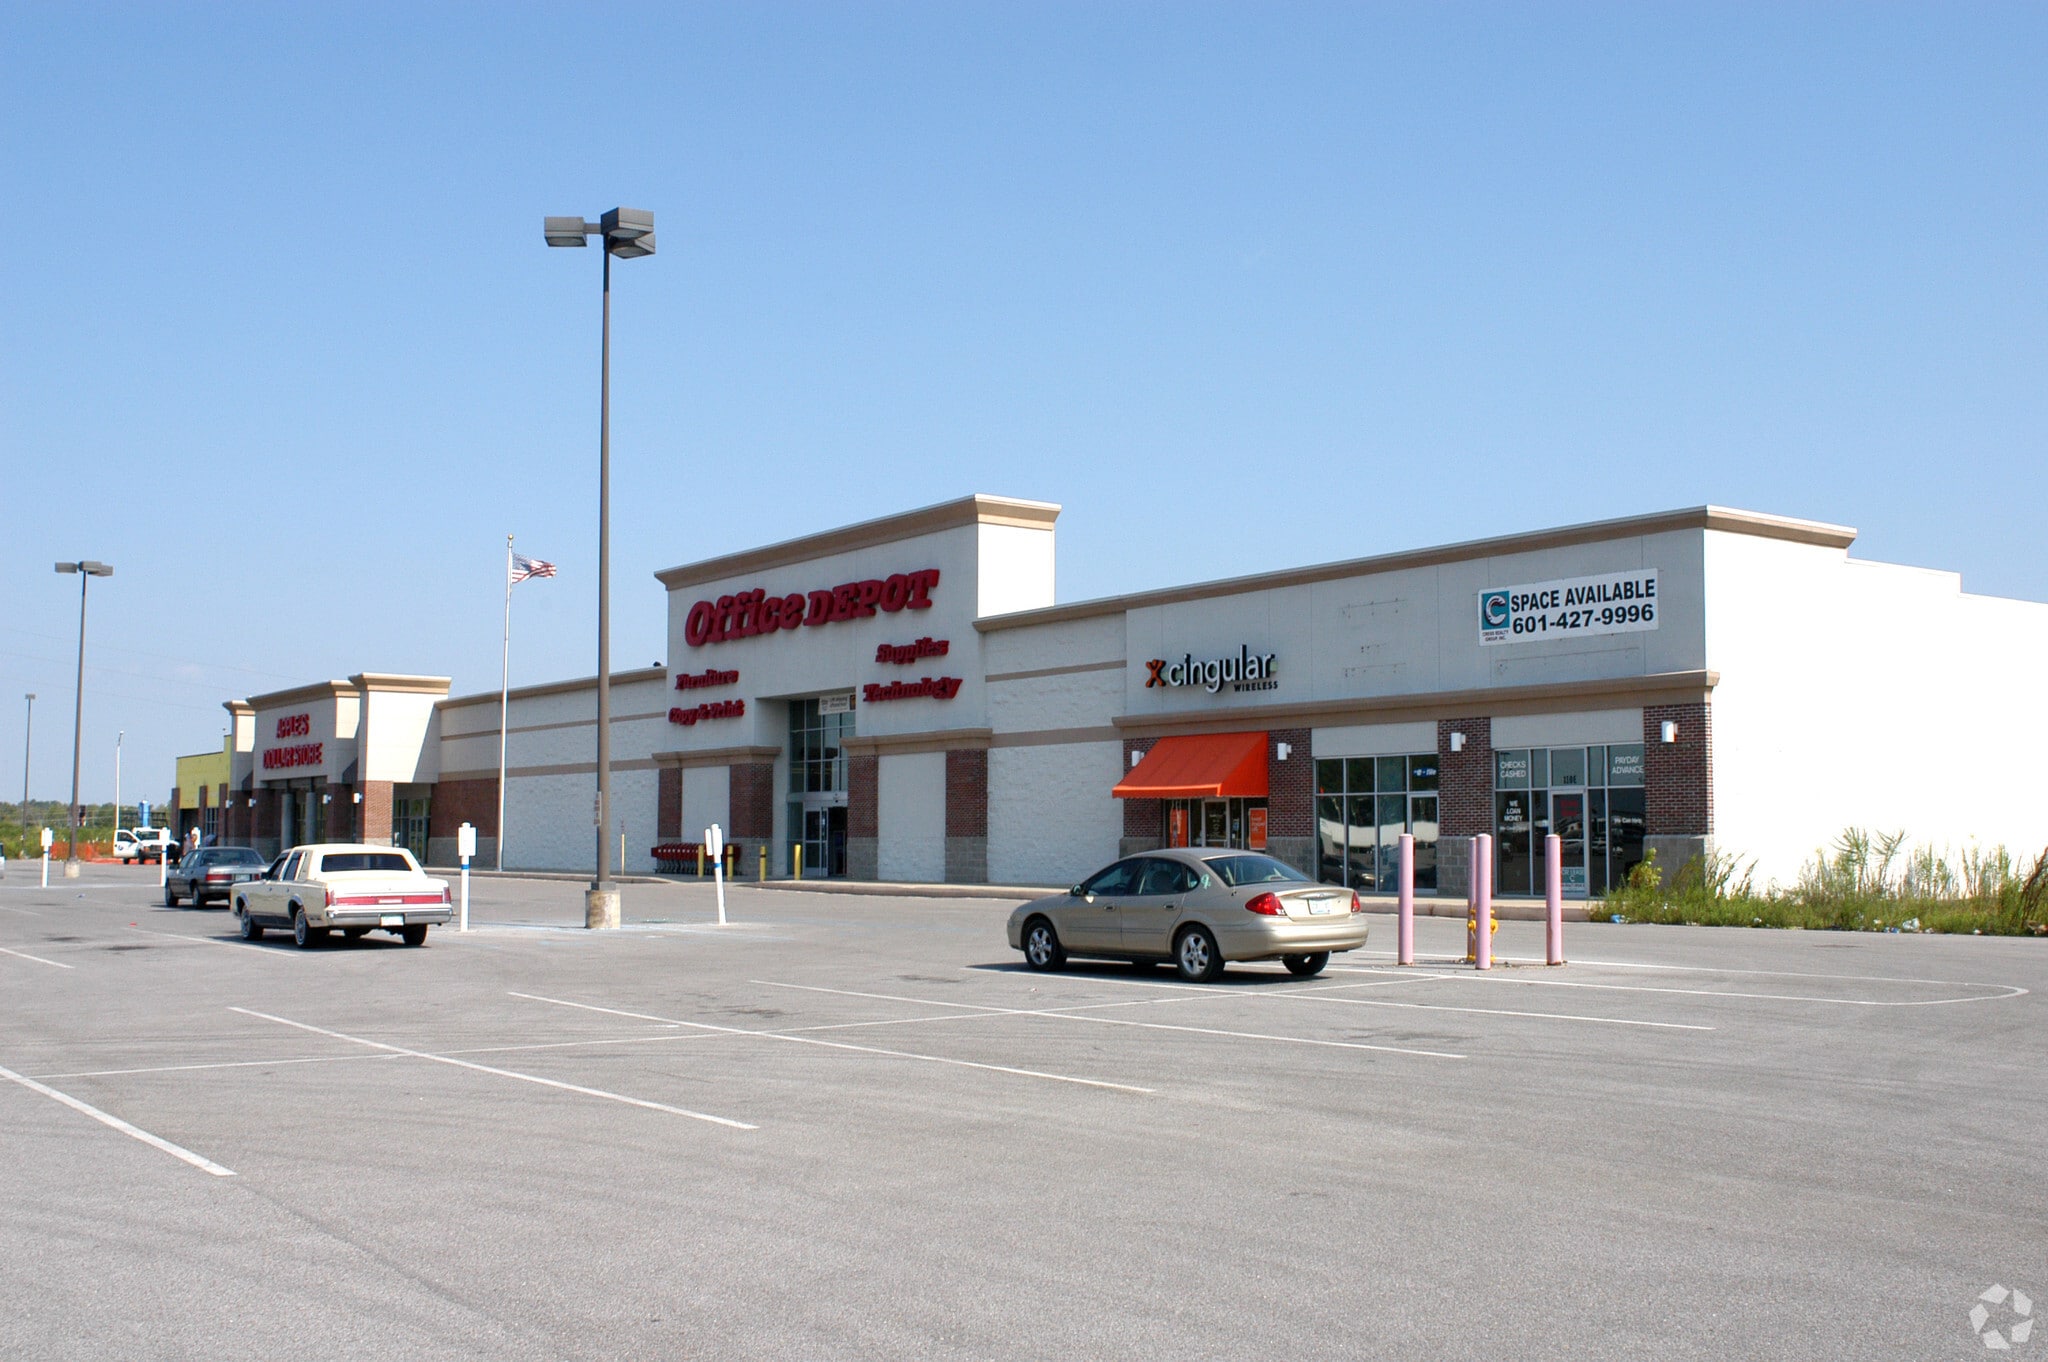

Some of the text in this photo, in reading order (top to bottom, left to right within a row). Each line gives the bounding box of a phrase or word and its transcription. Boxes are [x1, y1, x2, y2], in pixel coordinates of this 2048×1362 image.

[685, 568, 940, 646] Office DEPOT
[1511, 579, 1656, 613] SPACE AVAILABLE
[1512, 603, 1654, 634] 601-427-9996
[875, 637, 950, 664] Supplies
[675, 668, 739, 690] Furniture
[1168, 644, 1276, 693] cingular
[863, 676, 962, 702] Technology
[1234, 680, 1279, 692] WIRELESS
[668, 707, 698, 725] Copy
[709, 698, 745, 719] Print
[263, 742, 323, 769] DOLLAR STORE
[1500, 760, 1526, 769] CHECKS
[1614, 756, 1640, 764] PAYDAY
[1500, 769, 1527, 778] CASHED
[1611, 764, 1645, 774] ADVANCE
